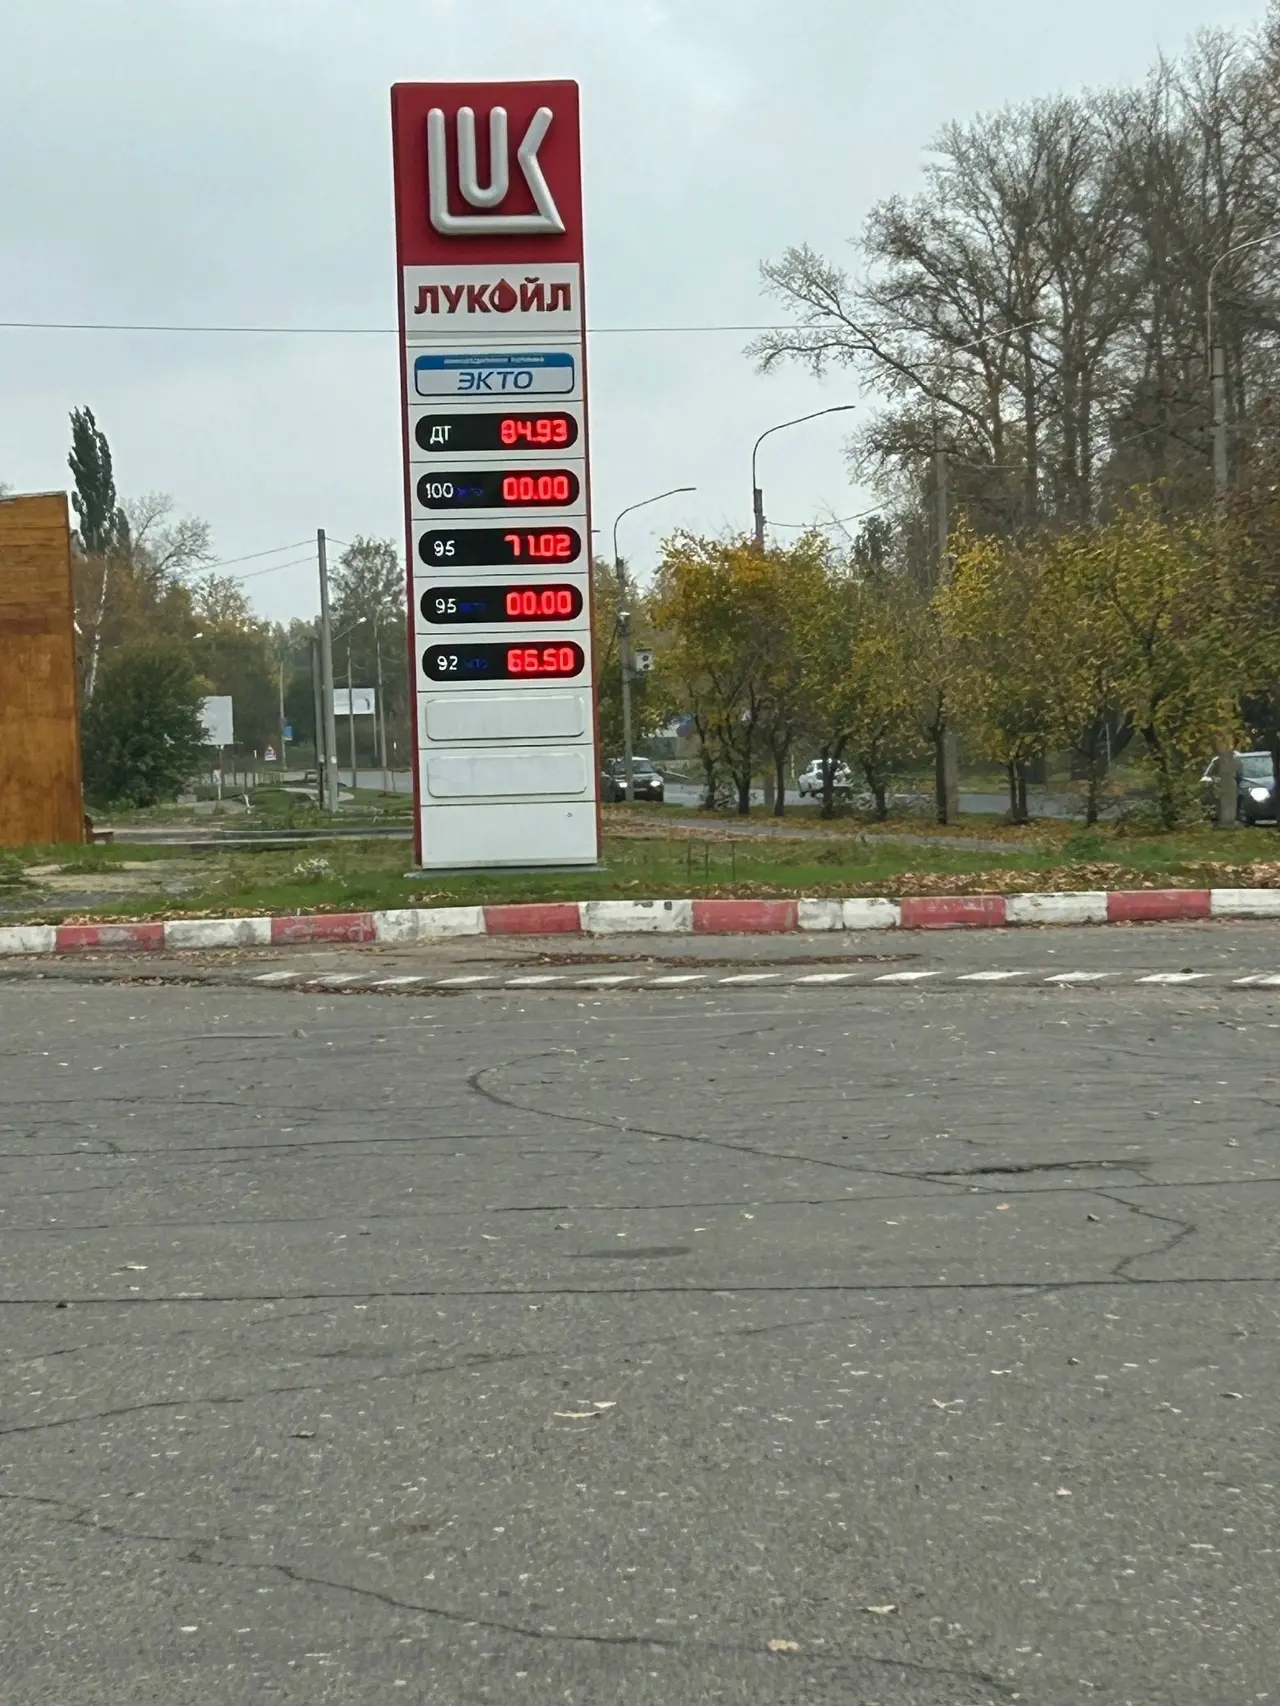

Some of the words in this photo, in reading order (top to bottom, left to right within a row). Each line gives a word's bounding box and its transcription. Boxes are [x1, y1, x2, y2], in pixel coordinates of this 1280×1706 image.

[414, 276, 572, 315] ЛУКОЙЛ
[457, 370, 533, 391] ЭКТО
[429, 425, 452, 444] ДТ
[425, 482, 454, 499] 100
[502, 475, 569, 500] 00.00
[433, 540, 456, 556] 95
[504, 534, 571, 557] 71.02
[435, 598, 457, 614] 95
[506, 590, 572, 615] 00.00
[436, 655, 459, 671] 92
[507, 647, 575, 672] 66.50
